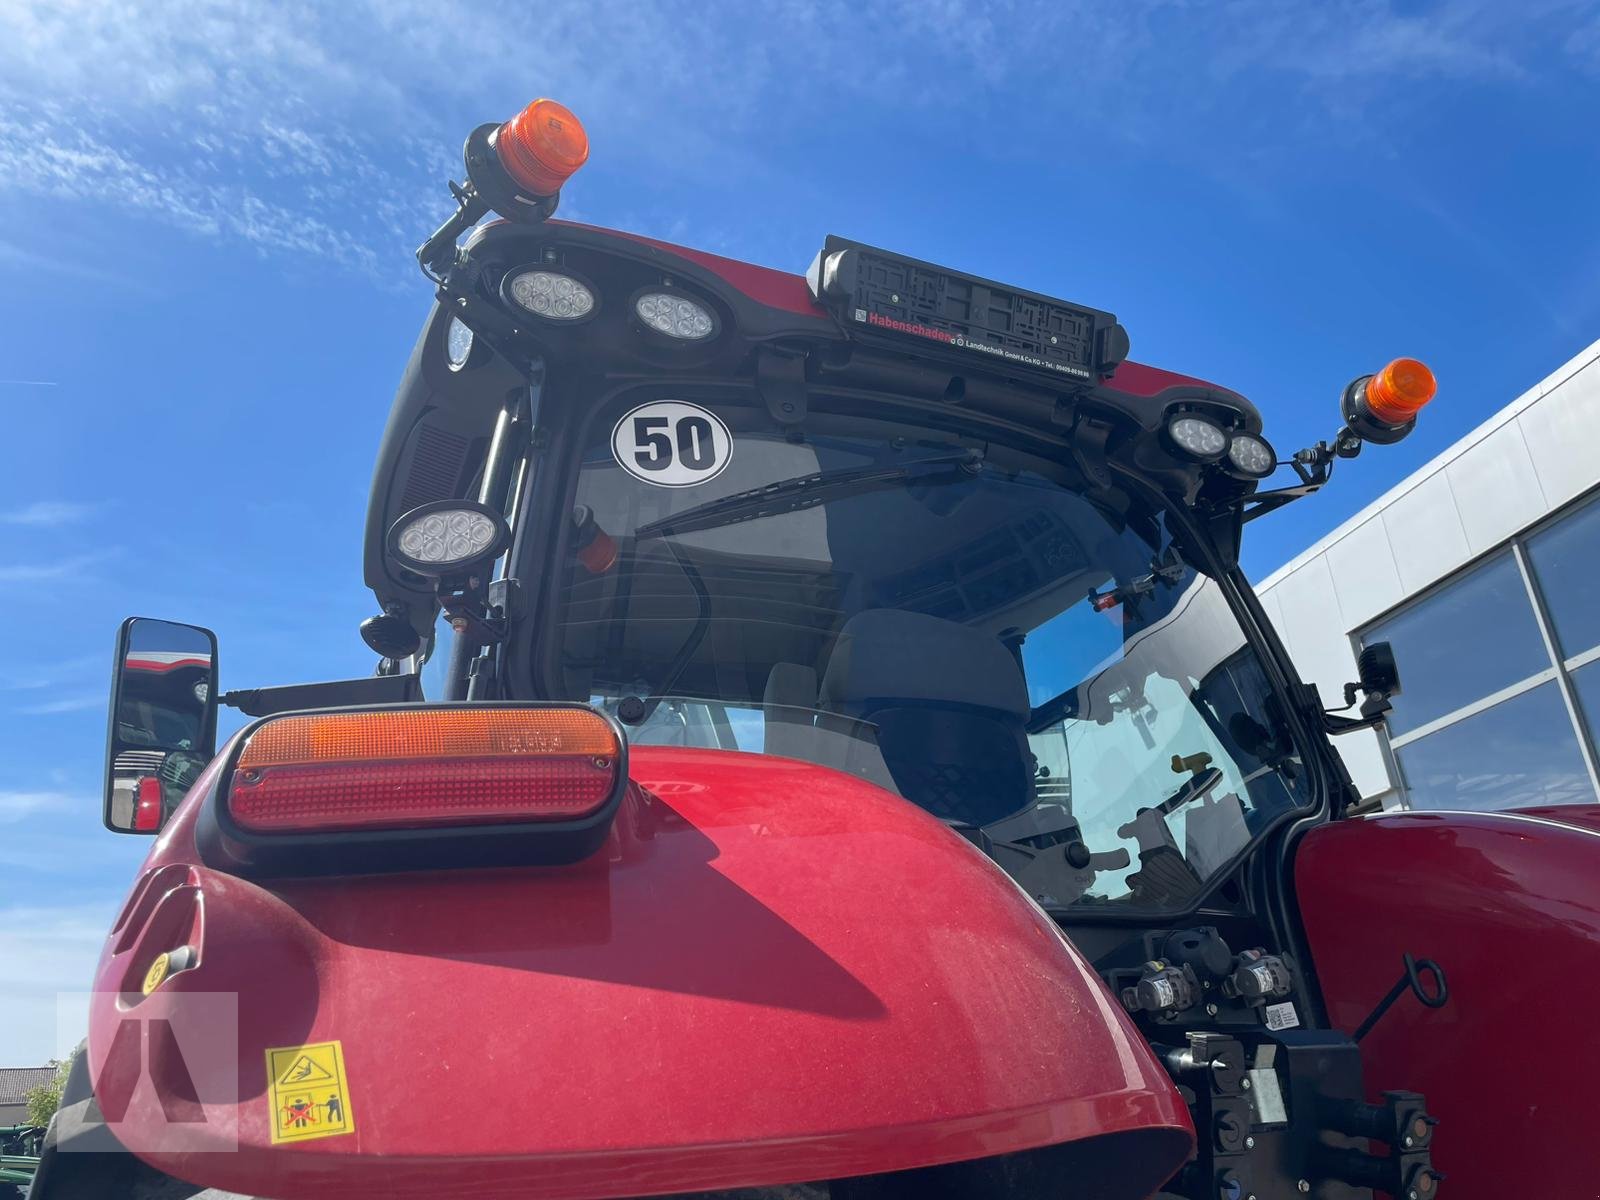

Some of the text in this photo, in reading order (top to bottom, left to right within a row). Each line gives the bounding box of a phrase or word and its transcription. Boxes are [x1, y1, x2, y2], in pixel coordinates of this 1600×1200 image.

[868, 311, 952, 343] Habenschaden
[965, 340, 1004, 357] Landtechnik
[1004, 351, 1020, 361] GmbH
[634, 416, 716, 471] 50
